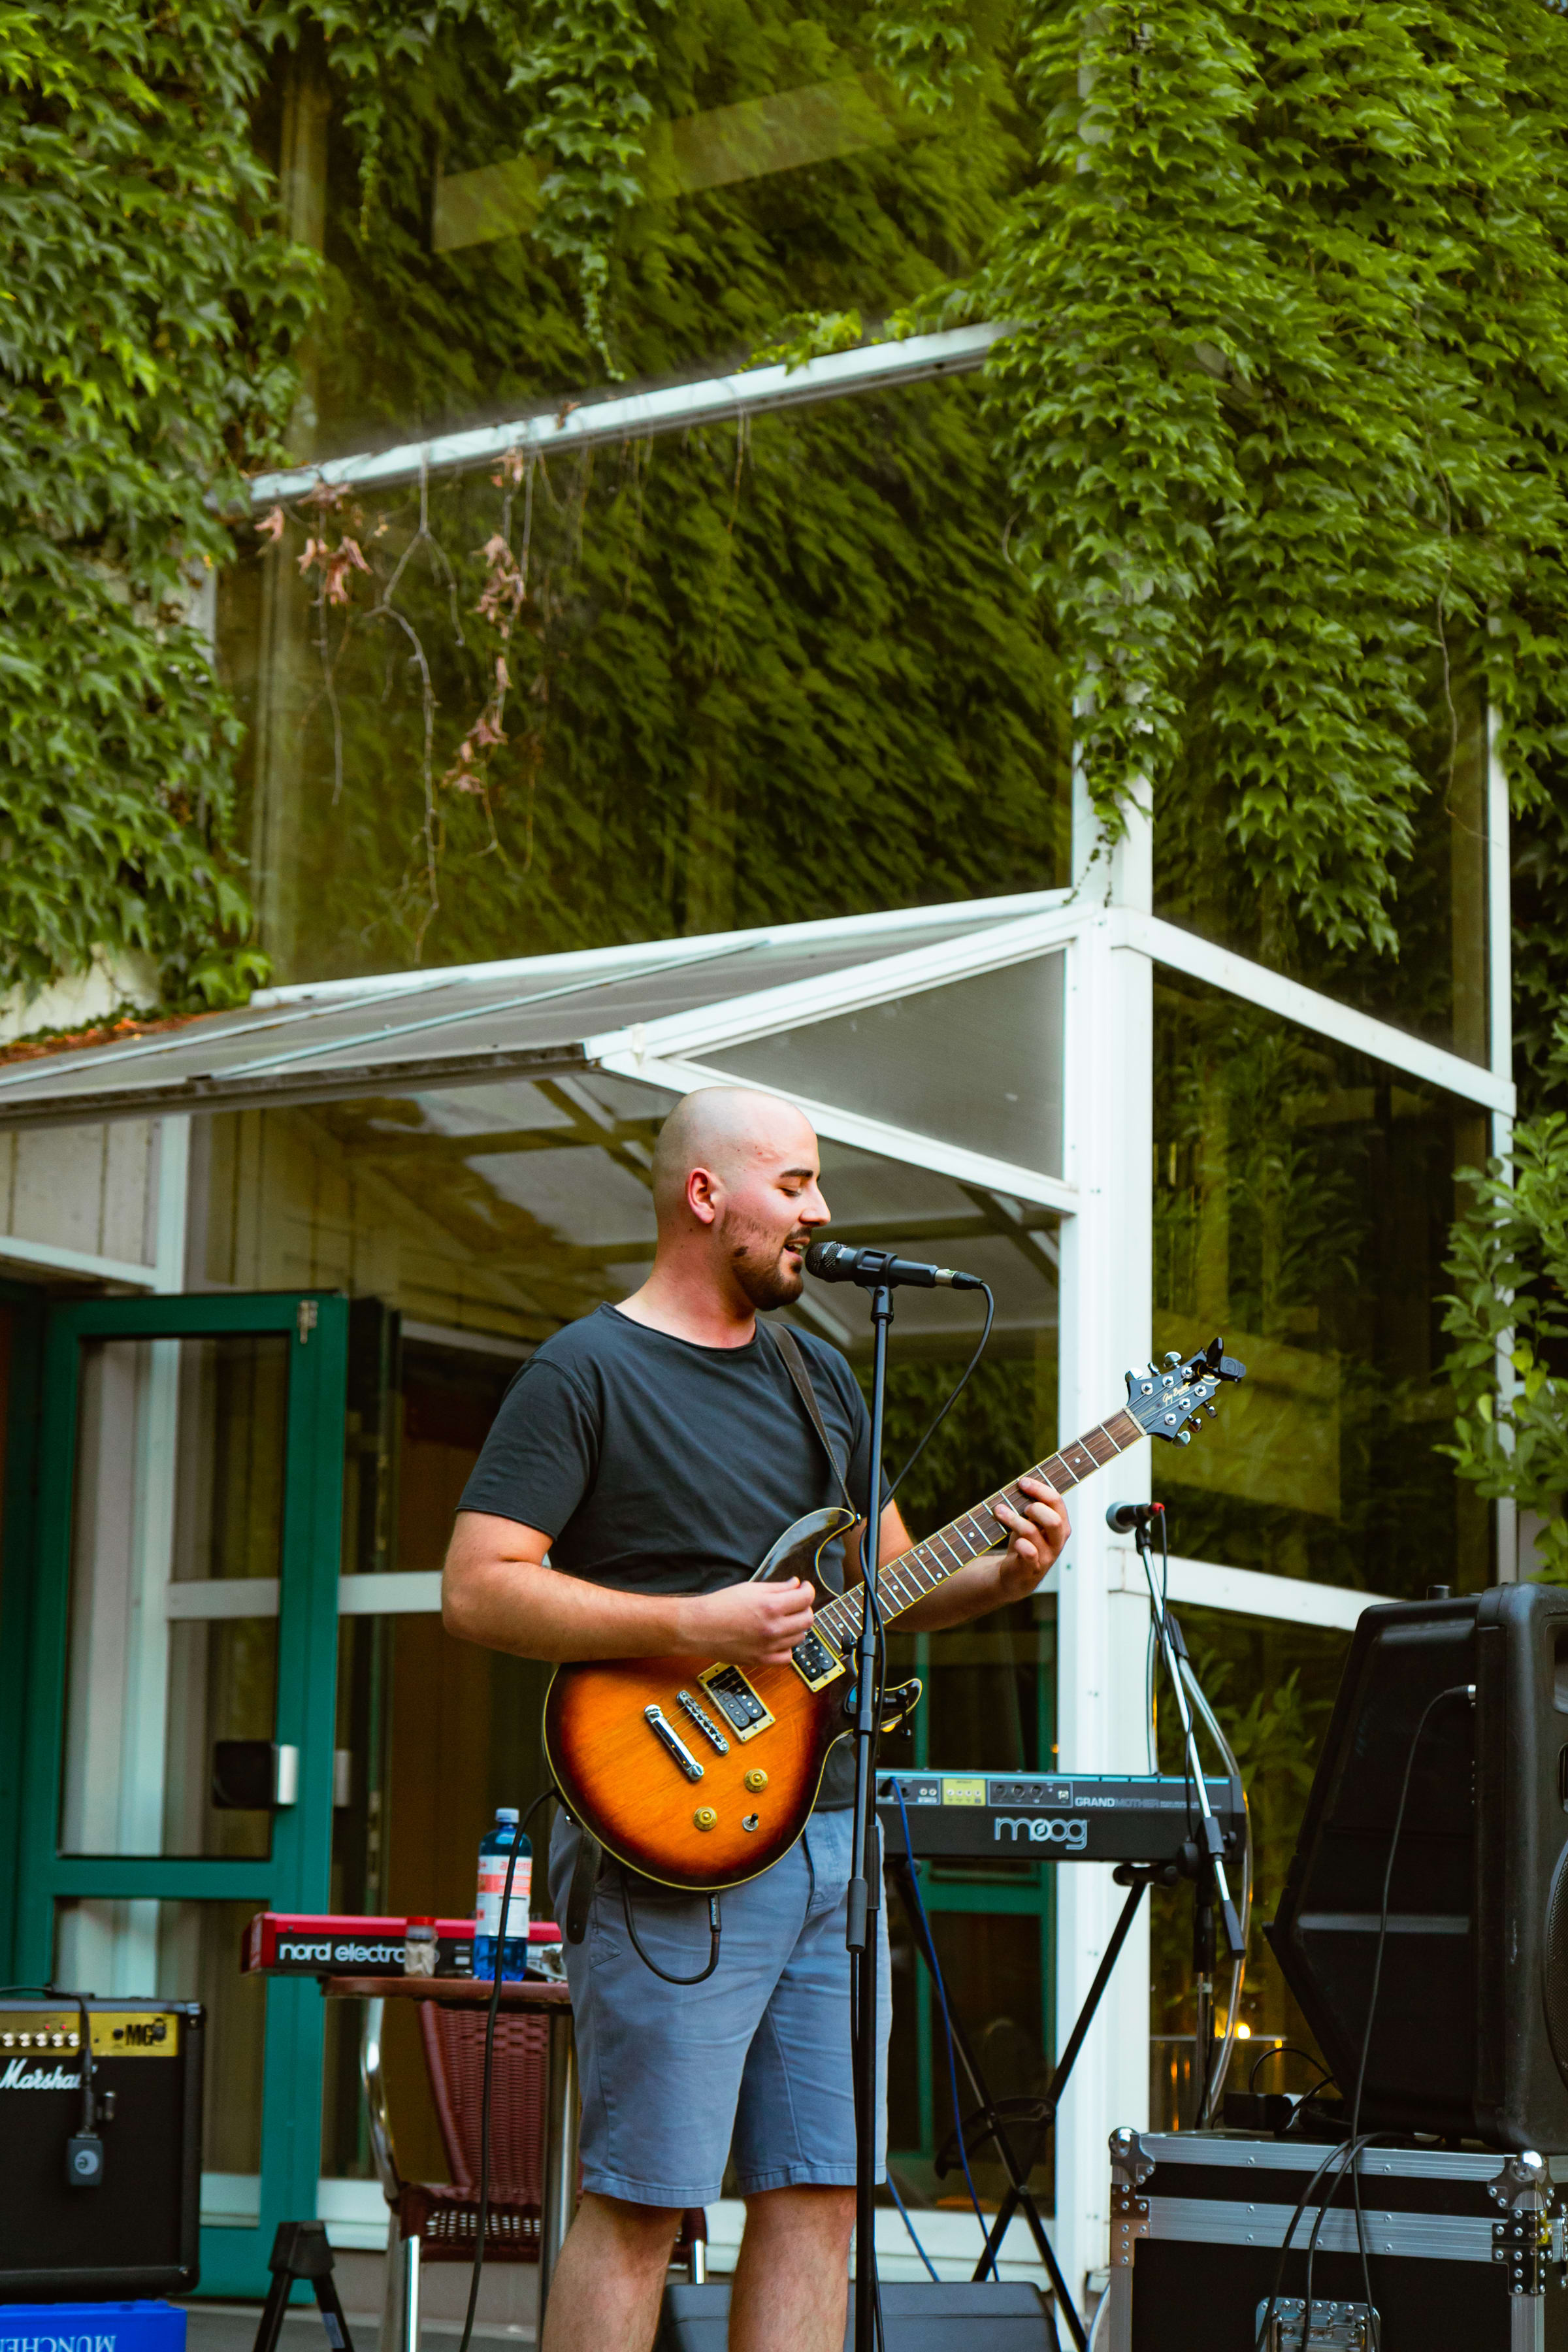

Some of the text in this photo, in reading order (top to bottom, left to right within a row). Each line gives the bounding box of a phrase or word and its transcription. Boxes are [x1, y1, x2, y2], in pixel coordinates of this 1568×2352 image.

[994, 1817, 1088, 1850] moog
[279, 1942, 331, 1961] nord
[0, 2058, 98, 2089] Marsha
